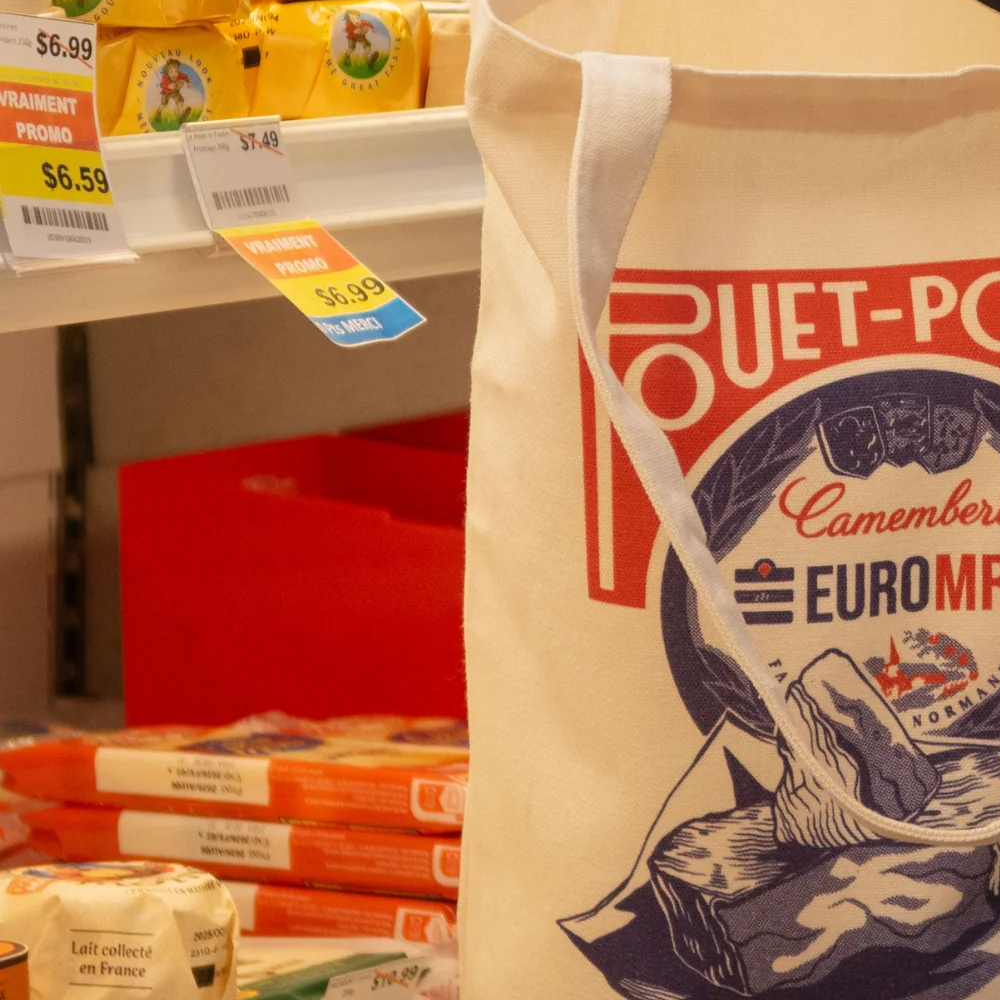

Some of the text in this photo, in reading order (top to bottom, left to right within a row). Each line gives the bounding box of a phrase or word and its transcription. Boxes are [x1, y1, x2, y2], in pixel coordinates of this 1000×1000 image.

[36, 31, 93, 62] $6.99
[136, 48, 213, 88] NOUVEAU LOOK
[341, 78, 379, 91] GREAT
[0, 90, 78, 116] VRAIMENT
[15, 121, 73, 145] PROMO
[239, 129, 280, 153] $7.49
[41, 160, 110, 195] $6.59
[243, 233, 318, 256] VRAIMENT
[274, 256, 329, 277] PROMO
[314, 276, 386, 309] $6.99
[340, 316, 383, 333] MERCI
[71, 940, 153, 960] Lait collecté
[79, 961, 147, 979] en France
